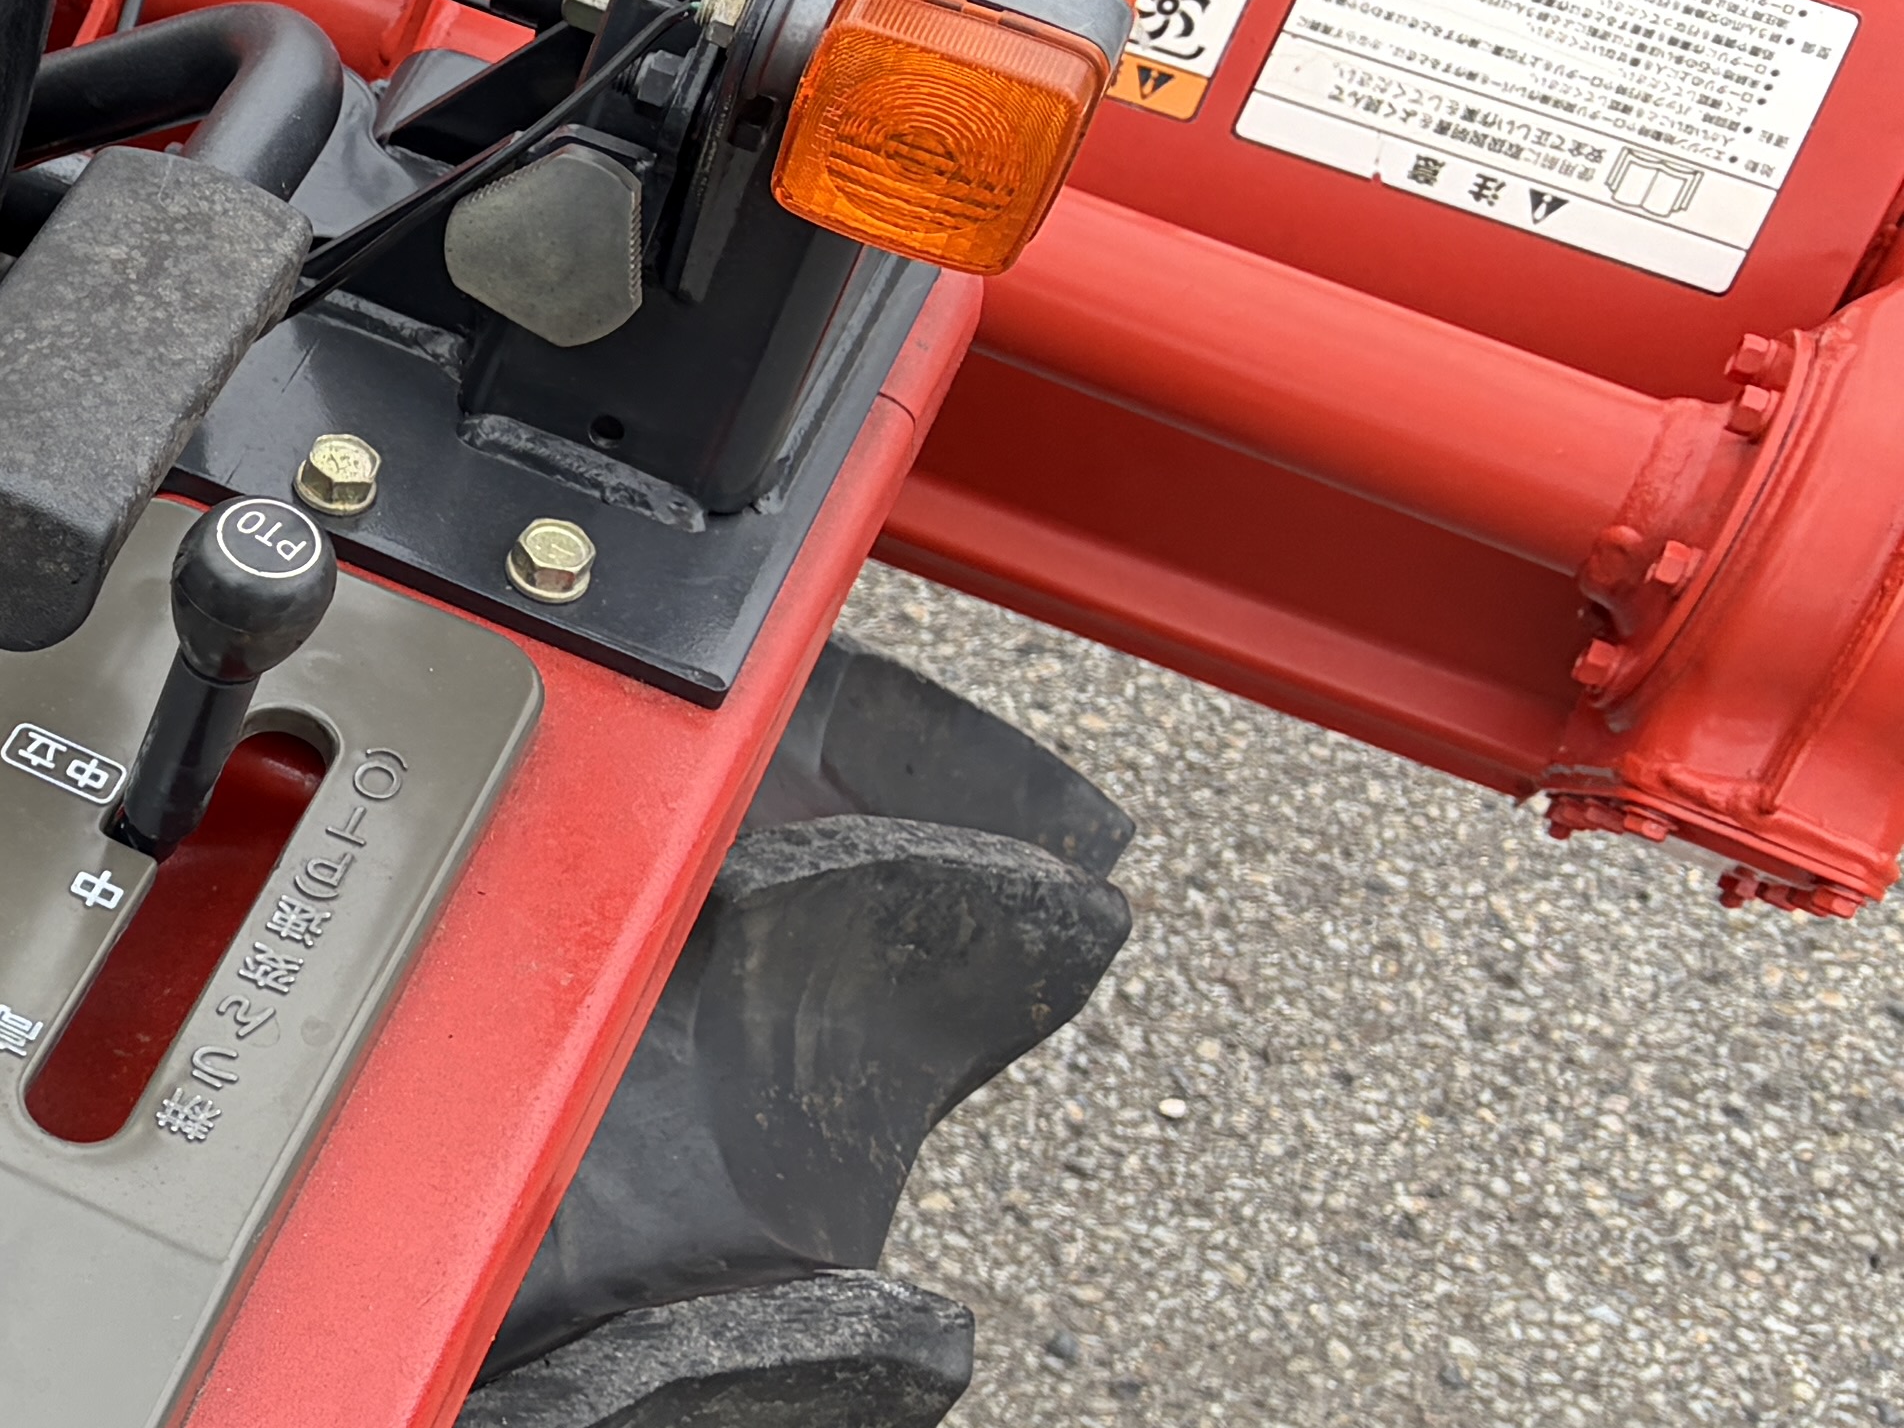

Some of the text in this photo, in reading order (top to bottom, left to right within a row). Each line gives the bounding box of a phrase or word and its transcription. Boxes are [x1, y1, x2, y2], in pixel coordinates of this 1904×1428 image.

[1403, 152, 1507, 208] 注意
[236, 510, 307, 561] PTO
[19, 731, 108, 789] 中立
[70, 871, 123, 910] 中
